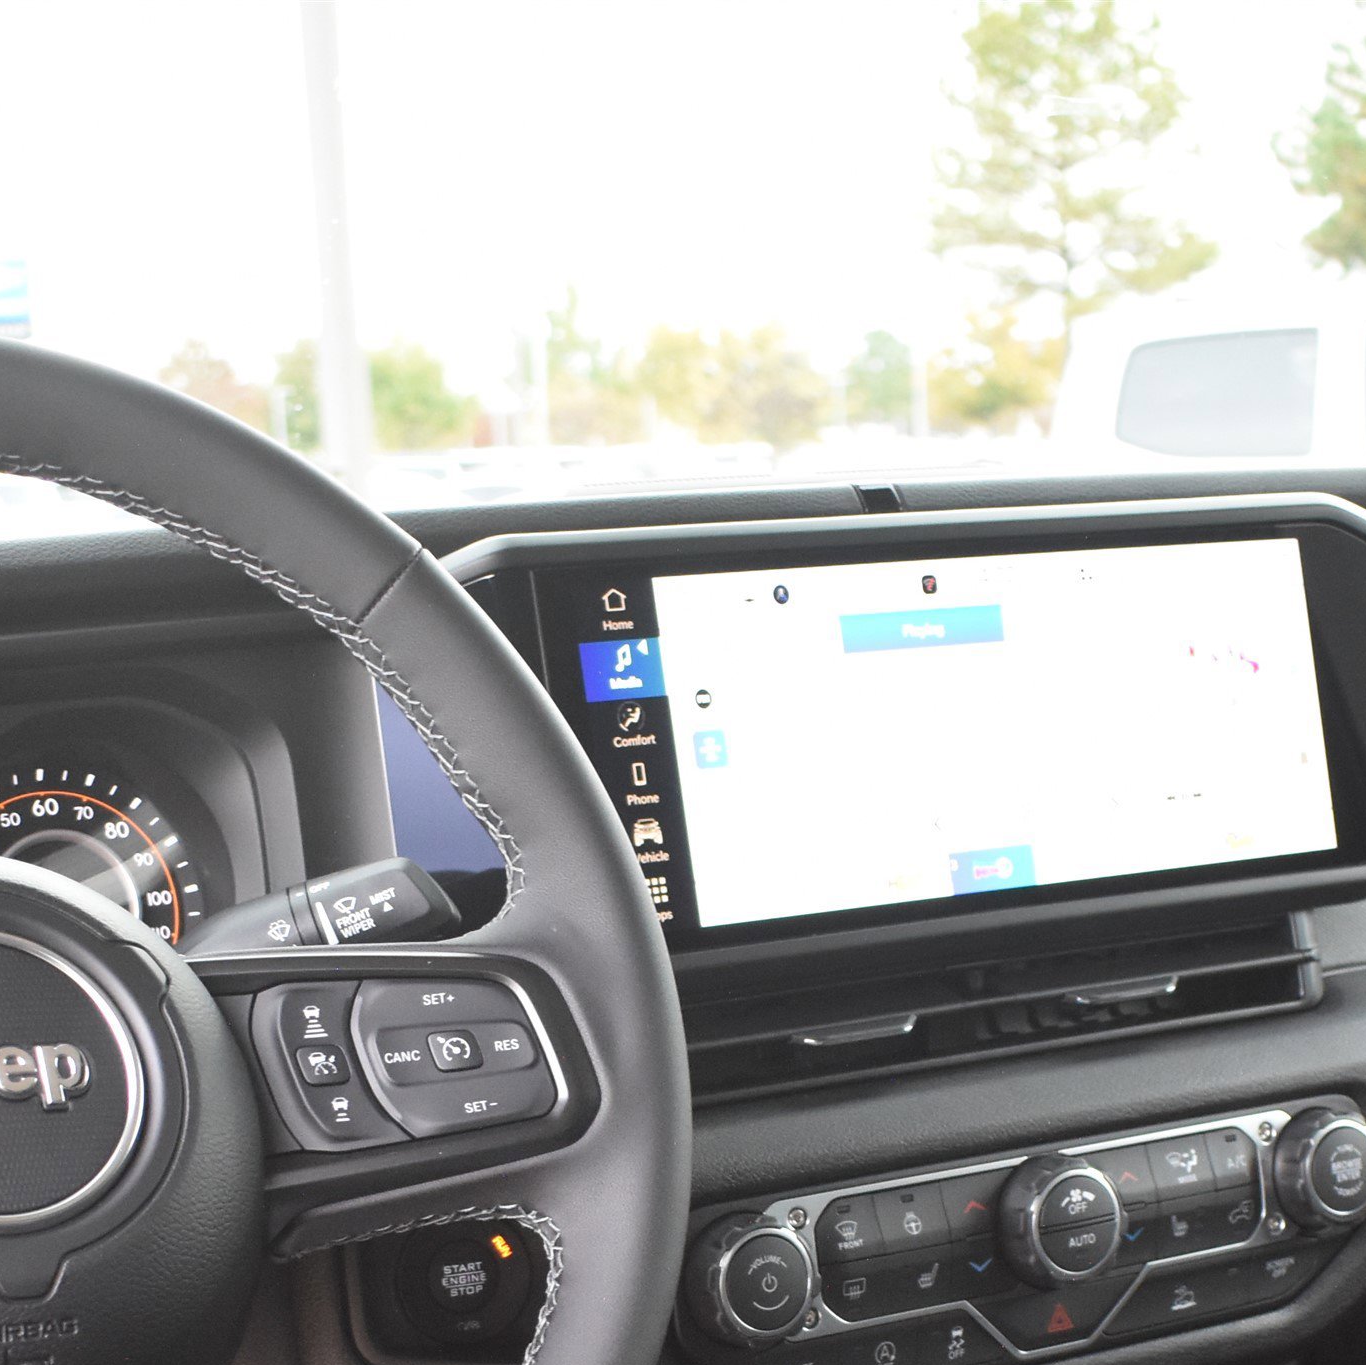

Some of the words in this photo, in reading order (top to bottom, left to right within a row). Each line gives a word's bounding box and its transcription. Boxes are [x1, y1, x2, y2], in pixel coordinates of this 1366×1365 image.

[603, 619, 634, 631] Home
[613, 733, 657, 748] Comfort
[32, 798, 59, 816] 60
[627, 793, 660, 806] Phone
[0, 812, 21, 828] 50
[73, 805, 94, 820] 70
[104, 821, 130, 839] 80
[134, 852, 154, 867] 90
[146, 890, 172, 906] 100
[369, 886, 396, 905] MIST
[335, 907, 372, 929] FRONT
[340, 917, 377, 939] WIPER
[494, 1038, 520, 1053] RES
[384, 1049, 422, 1064] CANC
[1227, 1154, 1247, 1169] A/C
[1069, 1203, 1089, 1215] OFF
[838, 1239, 864, 1251] FRONT
[1068, 1233, 1097, 1248] AUTO
[443, 1261, 483, 1275] START
[750, 1256, 782, 1270] VOLUME
[441, 1273, 488, 1287] ENGINE
[450, 1285, 484, 1297] STOP
[948, 1349, 965, 1361] OFF
